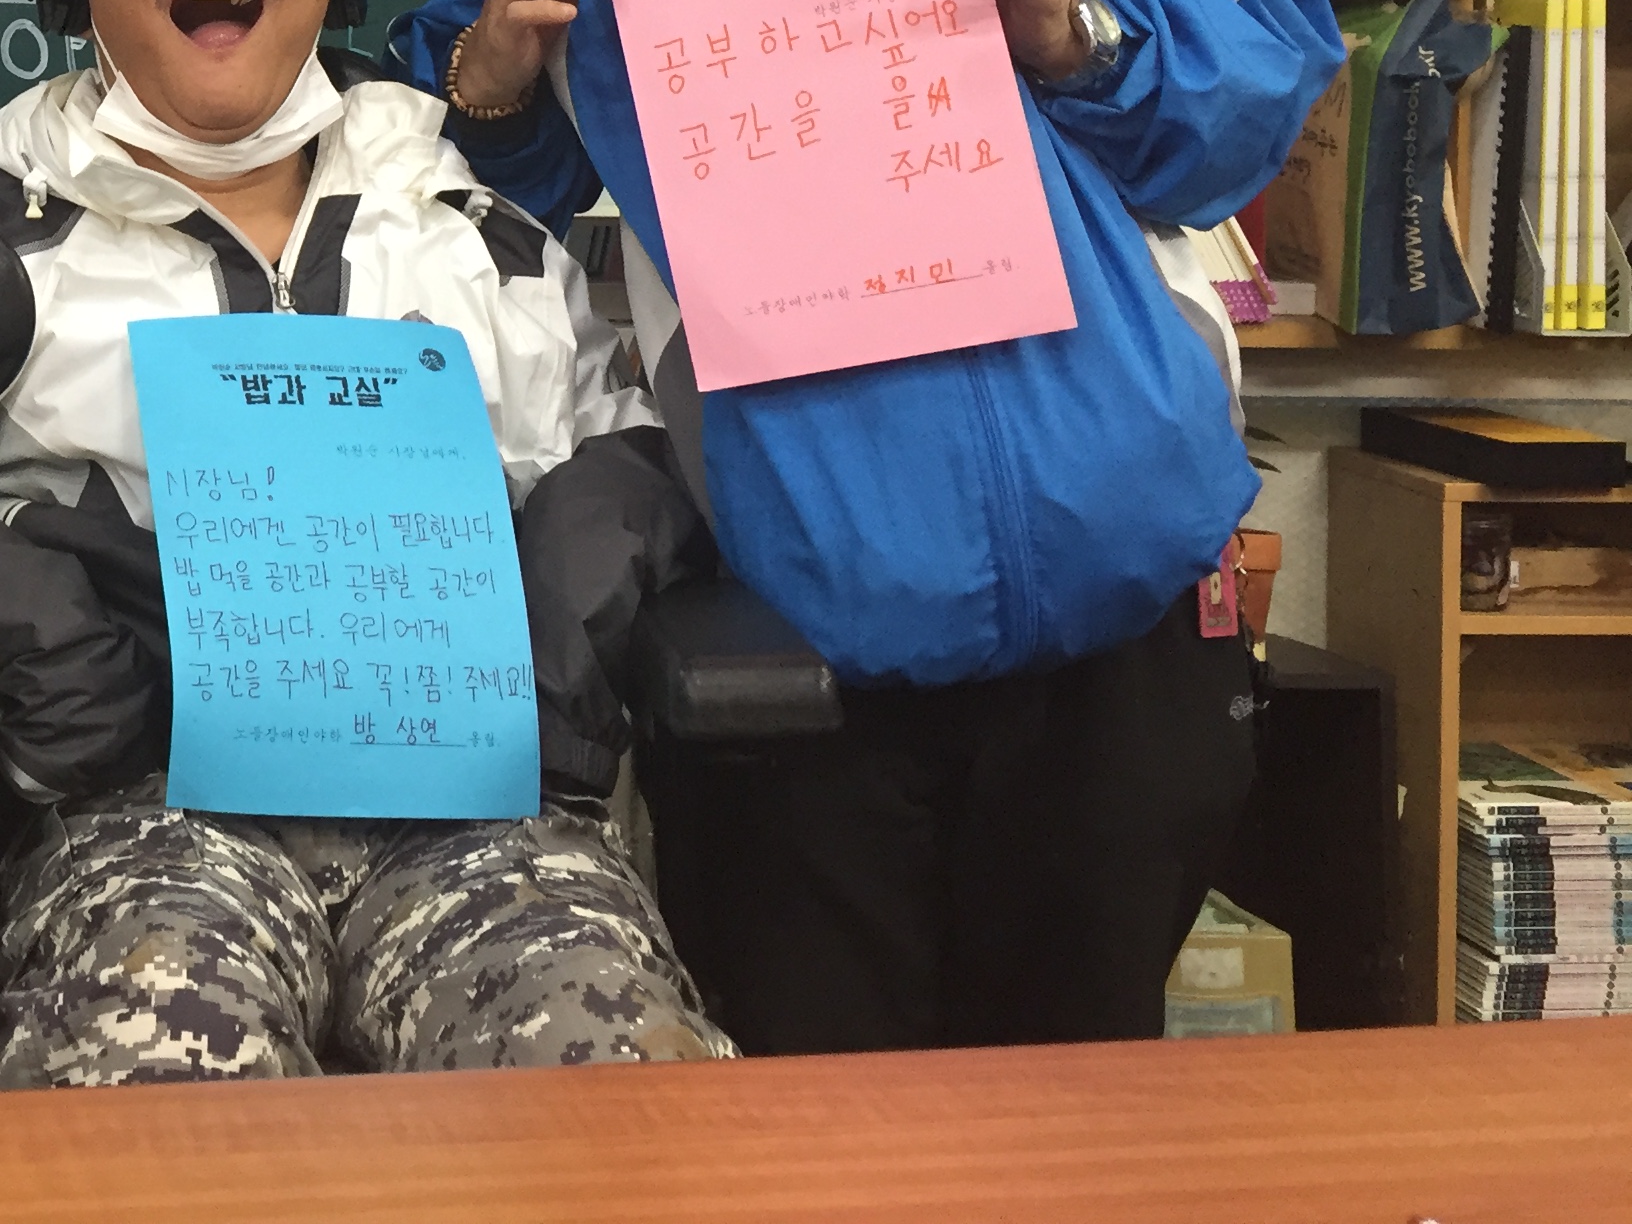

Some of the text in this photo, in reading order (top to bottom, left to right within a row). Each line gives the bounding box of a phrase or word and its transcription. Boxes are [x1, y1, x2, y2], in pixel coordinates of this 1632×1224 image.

[679, 90, 822, 181] 공간을
[886, 137, 1005, 194] 주세요
[166, 466, 275, 502] 시장님!
[175, 512, 297, 550] 우리에겐
[305, 512, 380, 554] 공간이
[209, 559, 253, 592] 먹을
[264, 560, 332, 593] 공간과
[344, 562, 416, 604] 공부할
[429, 566, 498, 602] 공간이
[186, 606, 451, 652] 부족합니다. 우리에게
[188, 654, 261, 702] 공간을
[275, 657, 354, 699] 주세요
[366, 661, 410, 707] 꼭!
